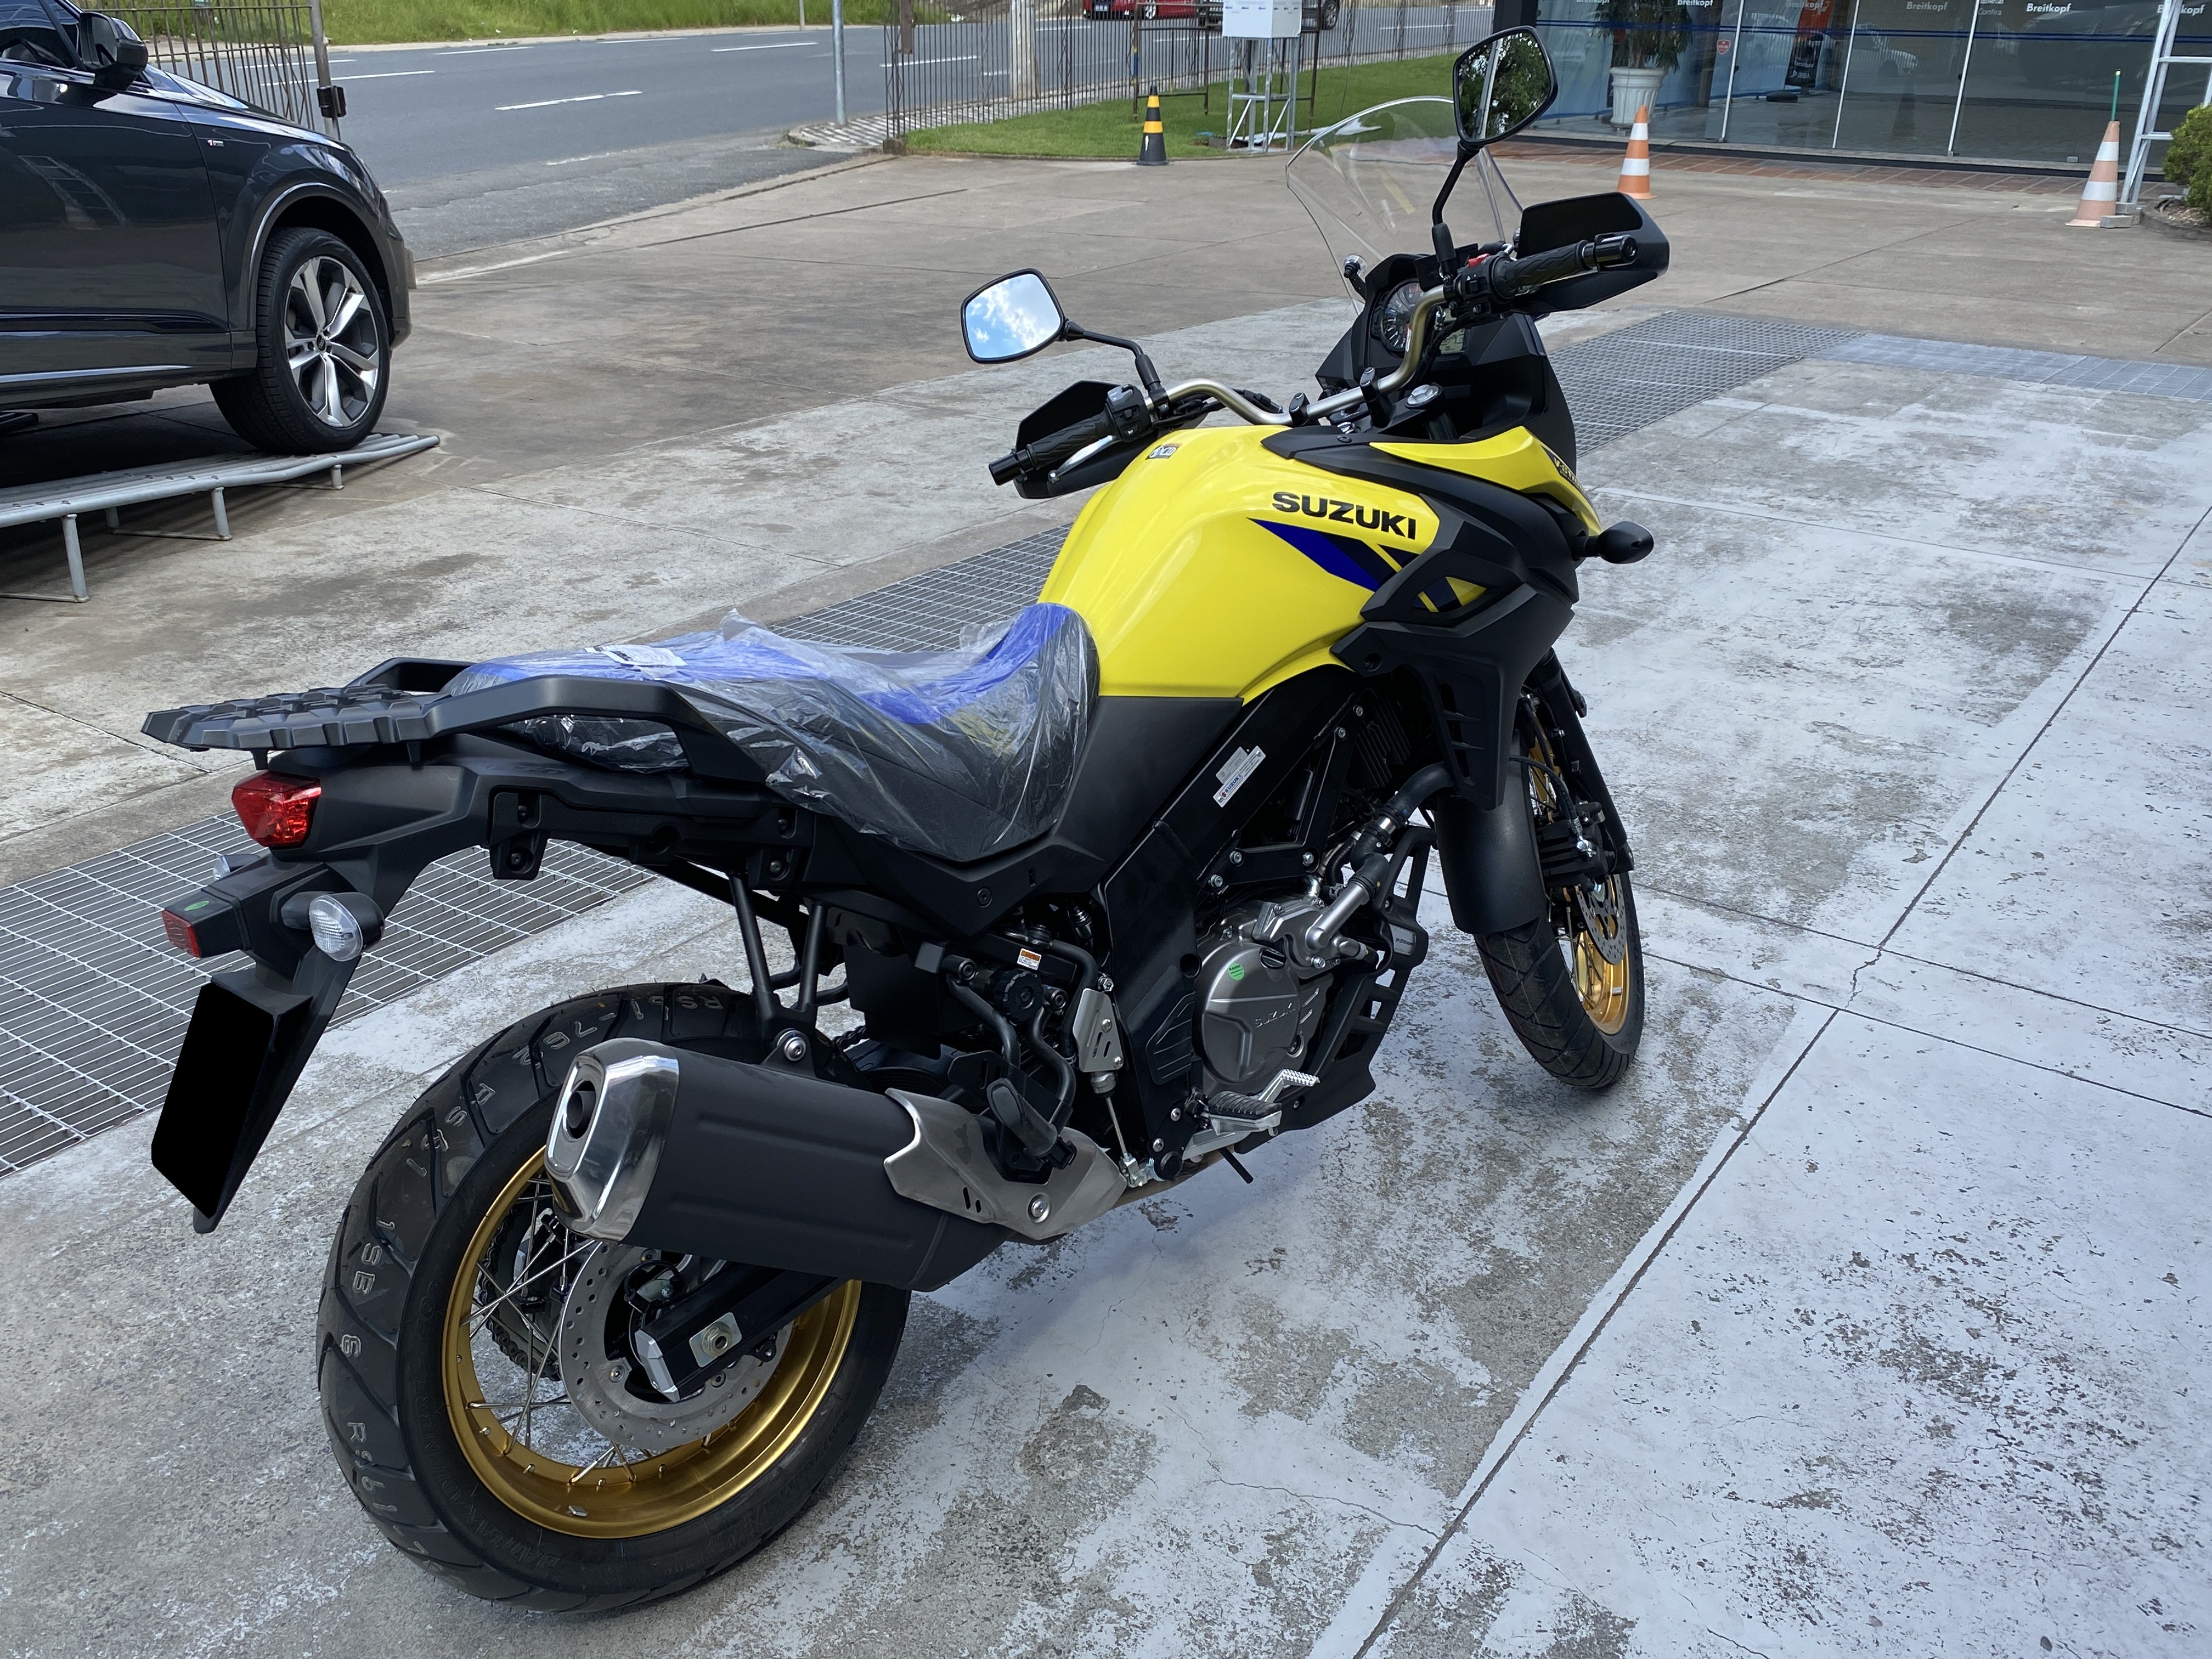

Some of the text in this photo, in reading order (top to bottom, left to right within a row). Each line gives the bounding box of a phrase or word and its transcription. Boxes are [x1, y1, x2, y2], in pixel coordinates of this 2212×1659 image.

[1906, 2, 1948, 11] Breitkopf
[2027, 3, 2072, 14] Breitkopf
[2157, 4, 2205, 16] Bkopf
[1272, 492, 1417, 540] SUZUKI
[1224, 774, 1242, 793] SUZUKI
